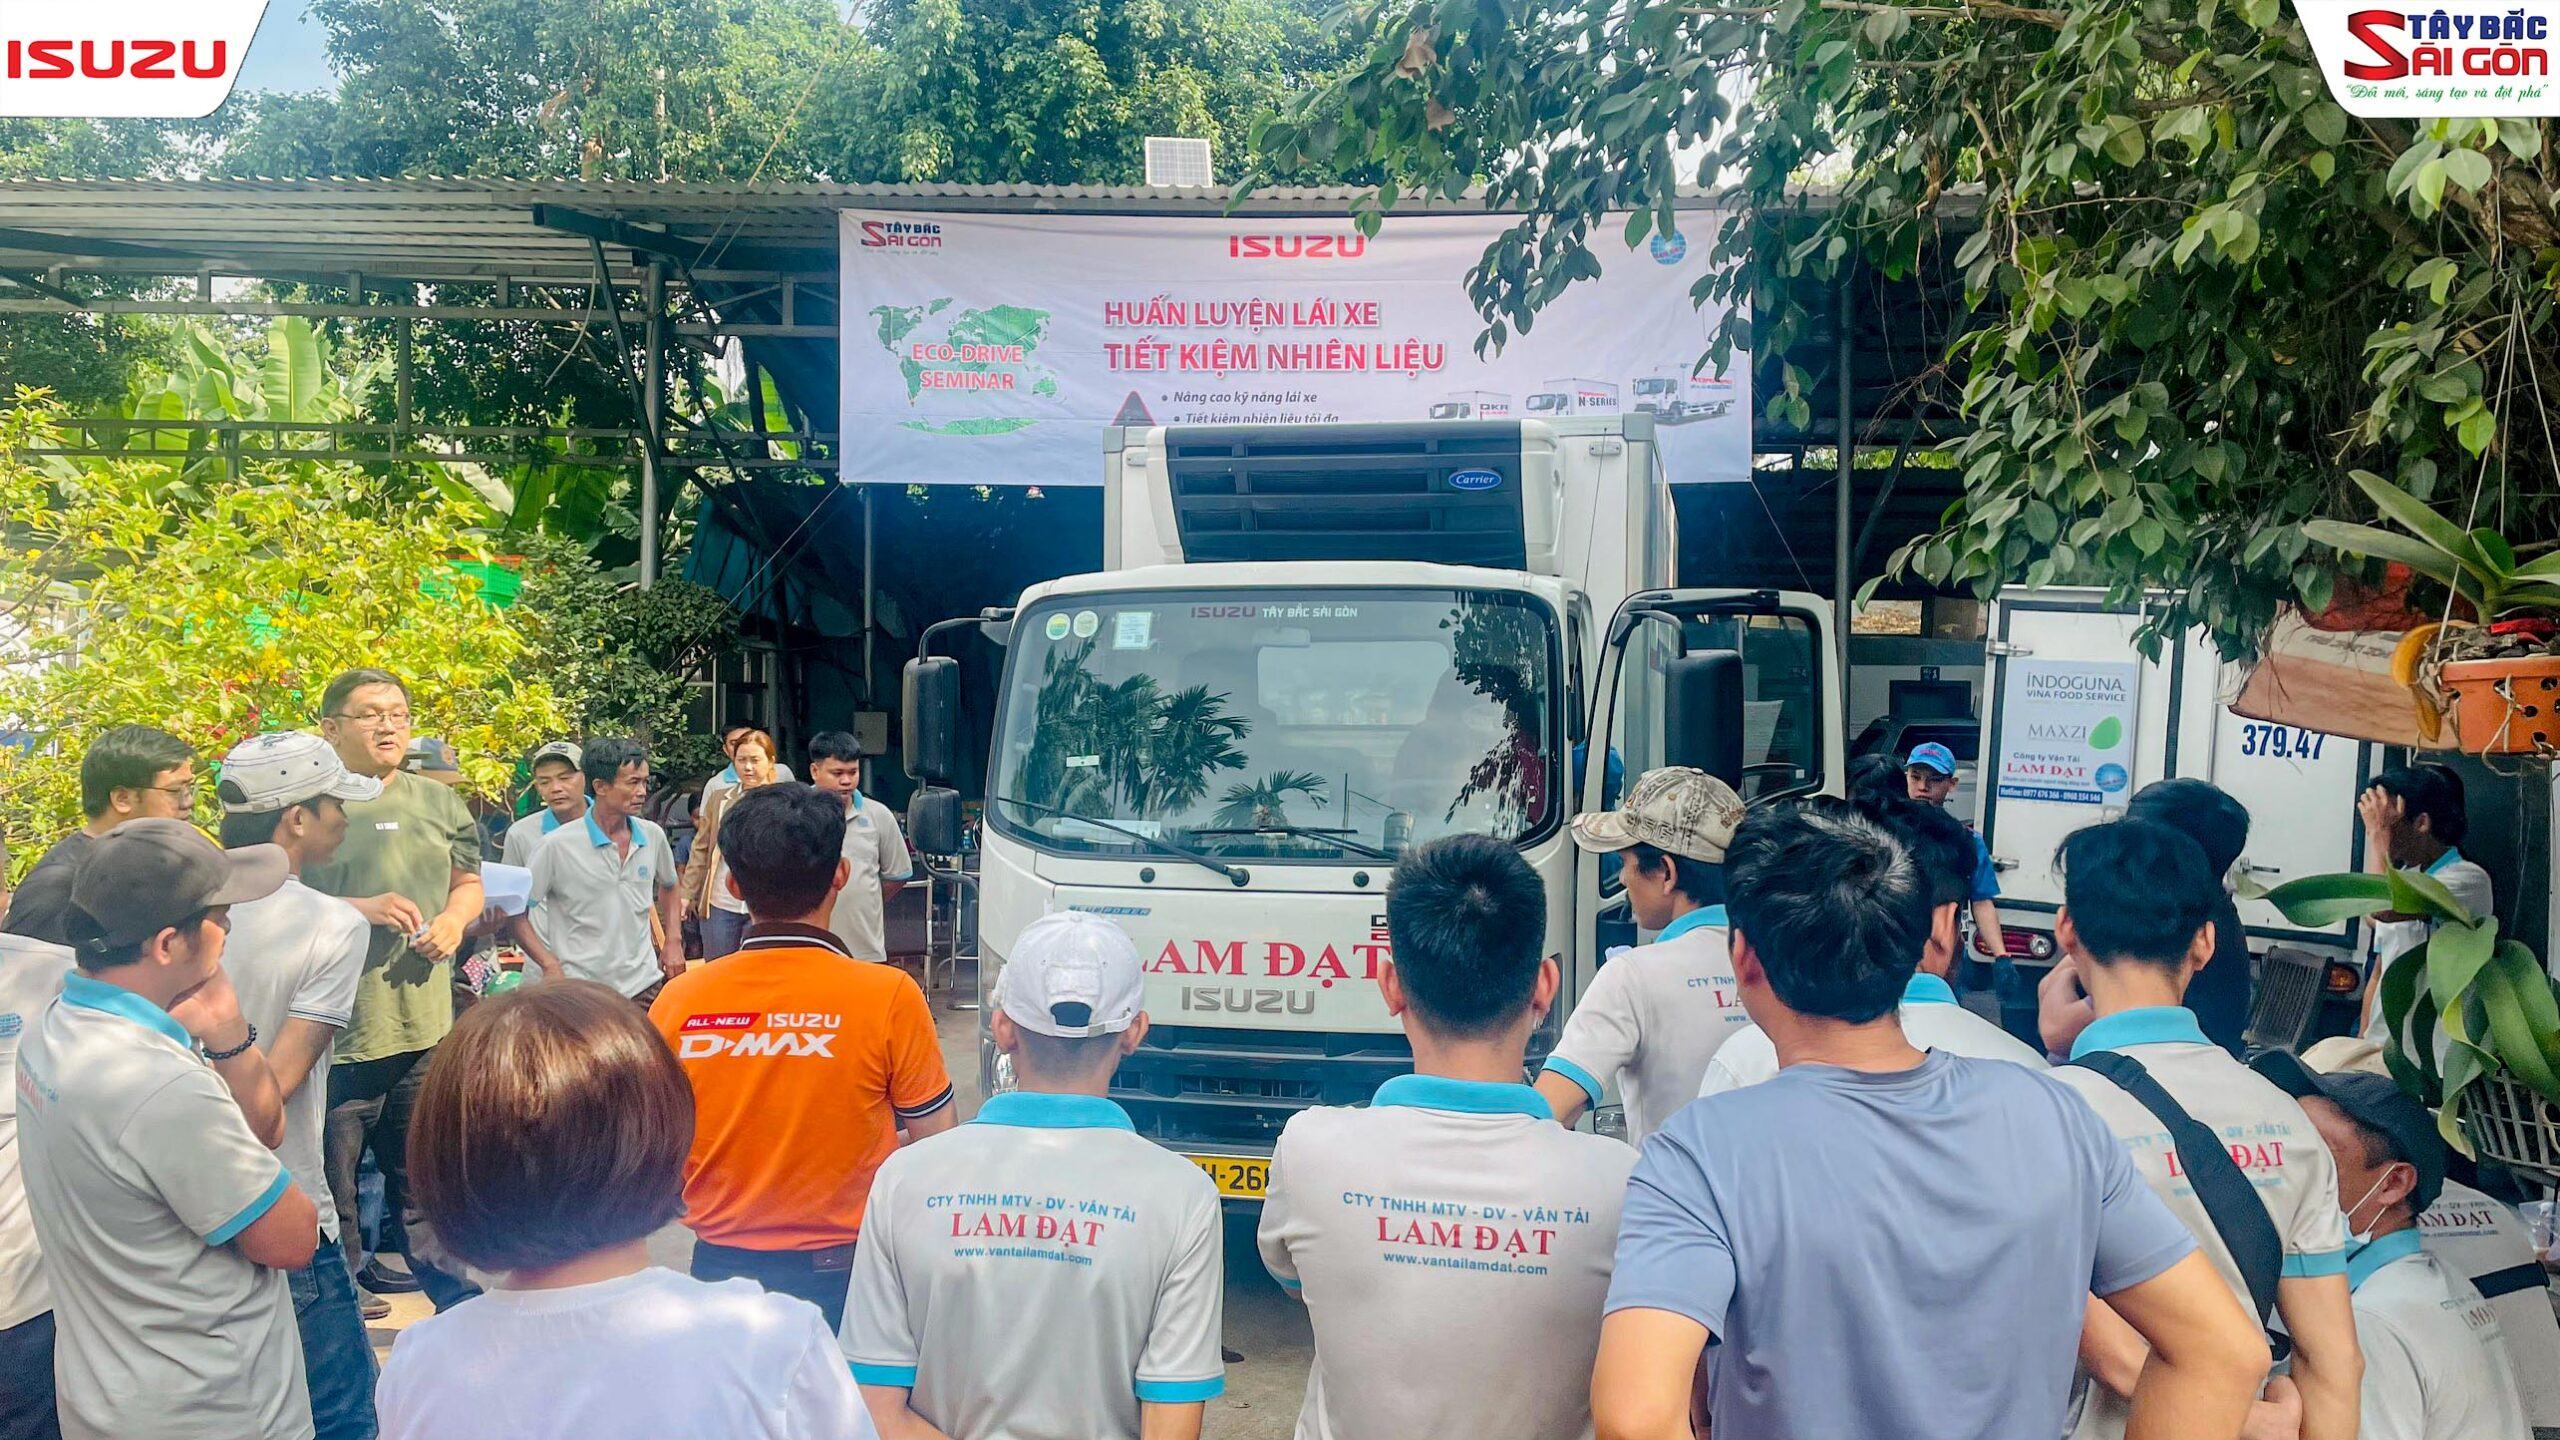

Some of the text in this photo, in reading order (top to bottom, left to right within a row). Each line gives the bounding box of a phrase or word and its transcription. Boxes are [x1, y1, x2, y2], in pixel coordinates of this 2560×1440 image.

[1230, 235, 1364, 257] ISUZU
[1105, 294, 1378, 332] HUẤN LUYỆN LÁI XE
[912, 343, 1023, 362] ECO-DRIVE
[1104, 334, 1443, 377] TIẾT KIỆM NHIÊN LIỆU
[921, 371, 1015, 389] SEMINAR
[1174, 391, 1206, 405] Nâng
[1210, 394, 1231, 403] cao
[1251, 391, 1283, 405] năng
[1285, 391, 1301, 403] lái
[1303, 394, 1317, 403] xe
[1243, 412, 1277, 423] nhiên
[1456, 474, 1494, 485] Carrier
[1191, 602, 1358, 618] ISUZU TÂY BẮC SÀI GÒN
[2054, 691, 2083, 700] FOOD
[2028, 723, 2086, 739] MAXZI
[2242, 724, 2325, 760] 379.47
[2007, 762, 2045, 775] LAM
[1142, 938, 1391, 988] AM ĐẠT
[1688, 976, 1735, 987] CTY TNH
[1182, 986, 1315, 1014] ISUZU
[687, 1013, 841, 1028] ALL-NEW ISUZU
[2229, 1141, 2285, 1173] ĐẠT
[927, 1194, 954, 1208] CTY
[958, 1194, 997, 1206] TNHH
[1002, 1195, 1032, 1208] MTV
[1046, 1197, 1065, 1210] DV
[1079, 1200, 1109, 1217] VẬN
[1113, 1206, 1136, 1223] TẢI
[1343, 1192, 1374, 1207] CTY
[1380, 1197, 1426, 1212] TNHH
[1432, 1202, 1467, 1216] MTV
[1483, 1207, 1506, 1220] DV
[1523, 1206, 1558, 1224] VẬN
[1564, 1207, 1589, 1223] TẢI
[2450, 1210, 2494, 1228] ĐẠT
[951, 1212, 1104, 1248] LAM ĐẠT
[1377, 1216, 1556, 1258] LAM ĐẠT
[954, 1247, 1093, 1266] www.vantailamdat.com
[1384, 1251, 1548, 1275] www.vantailamdat.com
